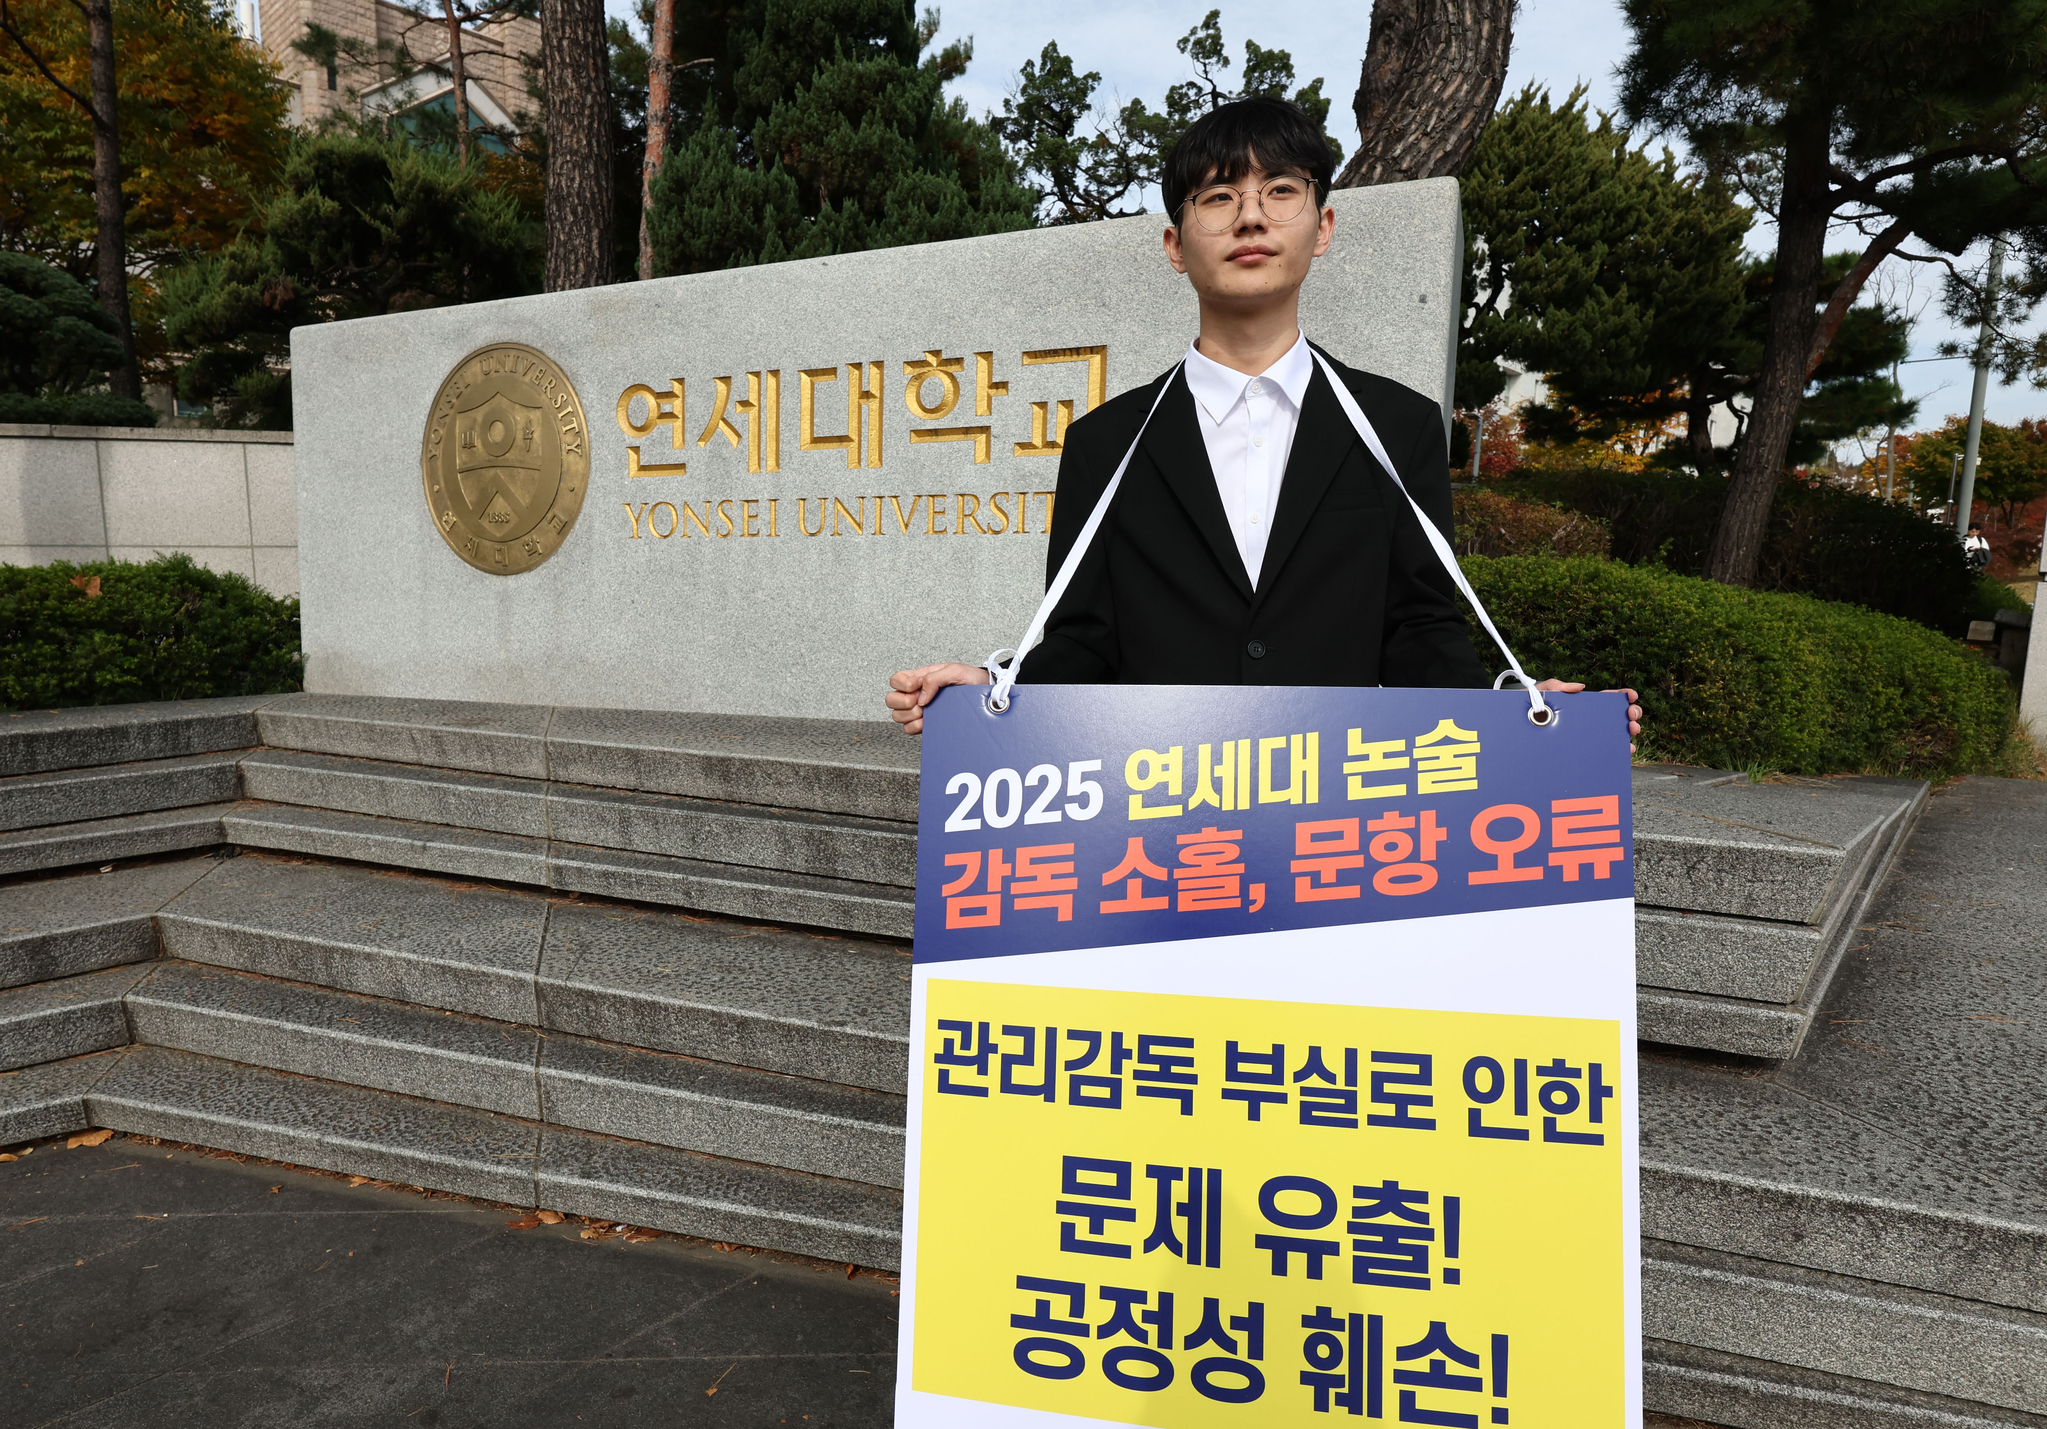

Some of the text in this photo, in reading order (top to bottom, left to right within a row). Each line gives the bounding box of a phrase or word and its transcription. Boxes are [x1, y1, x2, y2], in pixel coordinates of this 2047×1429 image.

[428, 354, 583, 461] YONSEI UNIVERSITY
[616, 345, 1107, 478] 연세대학교
[622, 491, 1056, 539] YONSEI UNIVERSIT
[944, 718, 1481, 833] 2025 연세대 논술
[941, 794, 1625, 930] 감독 소홀, 문항 오류
[933, 1019, 1614, 1146] 관리감독 부실로 인한
[1055, 1155, 1461, 1291] 문제 유출!
[1010, 1274, 1509, 1429] 공정성 훼손!
